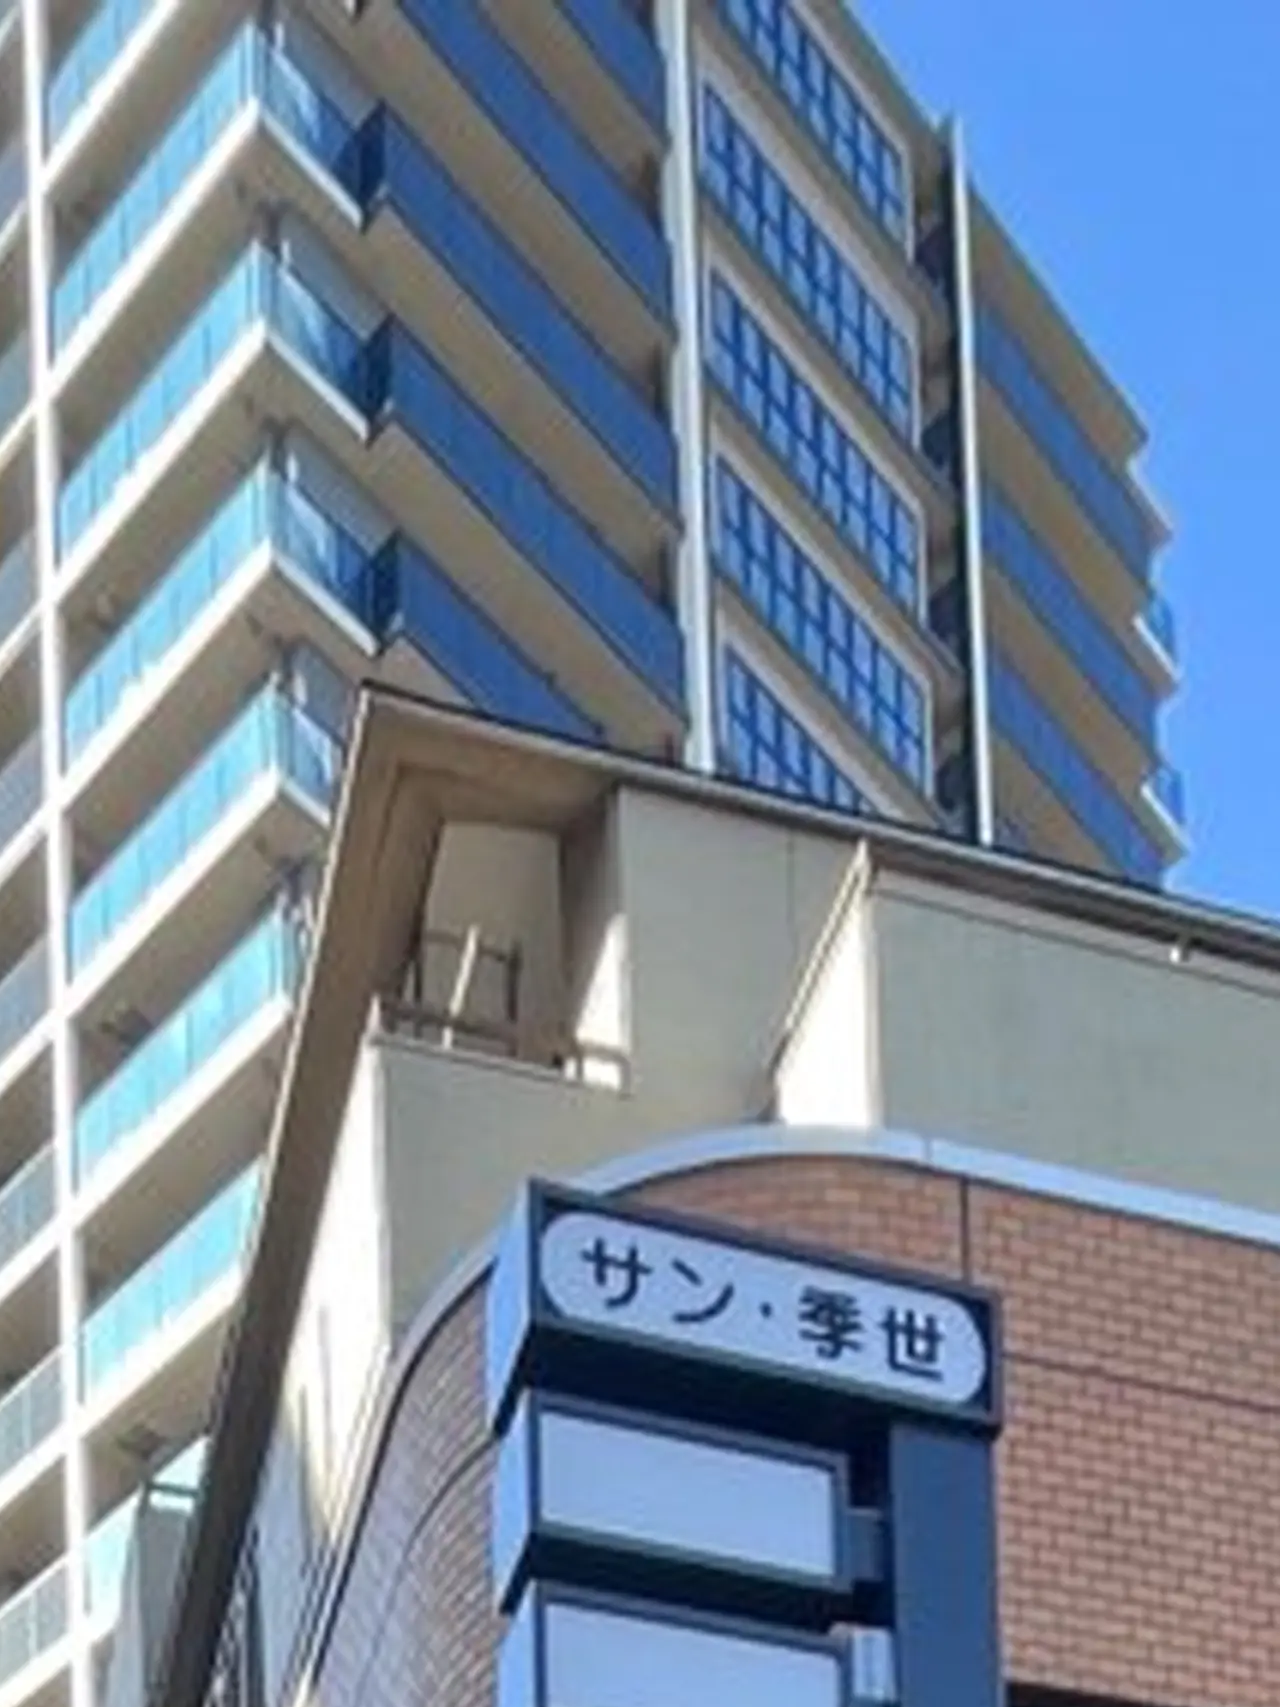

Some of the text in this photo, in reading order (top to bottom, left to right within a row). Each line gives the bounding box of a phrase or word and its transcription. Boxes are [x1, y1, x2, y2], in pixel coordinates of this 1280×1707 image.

[580, 1237, 945, 1381] サン・季世
